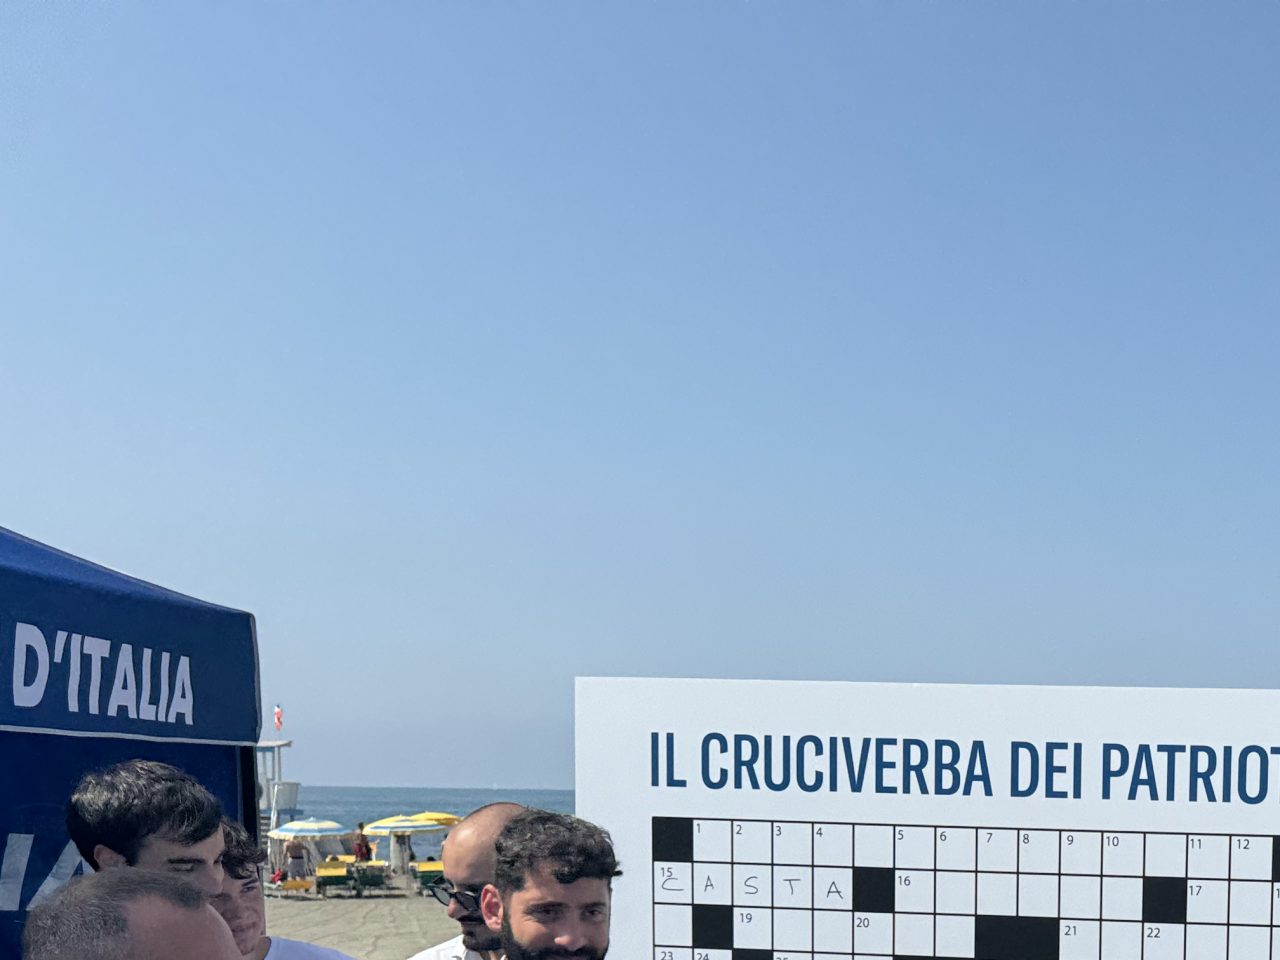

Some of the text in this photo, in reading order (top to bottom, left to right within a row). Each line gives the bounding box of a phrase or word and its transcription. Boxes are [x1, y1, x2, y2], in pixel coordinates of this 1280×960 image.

[13, 622, 194, 725] D'ITALIA
[651, 732, 687, 787] IL
[701, 732, 993, 797] CRUCIVERBA
[1010, 741, 1082, 799] DEI
[816, 827, 823, 837] 4
[1023, 834, 1029, 844] 8
[1106, 836, 1119, 846] 10
[1237, 839, 1249, 849] 12
[661, 867, 673, 877] 15
[898, 876, 911, 886] 16
[856, 917, 869, 928] 20
[1065, 925, 1076, 935] 21
[661, 951, 673, 960] 23
